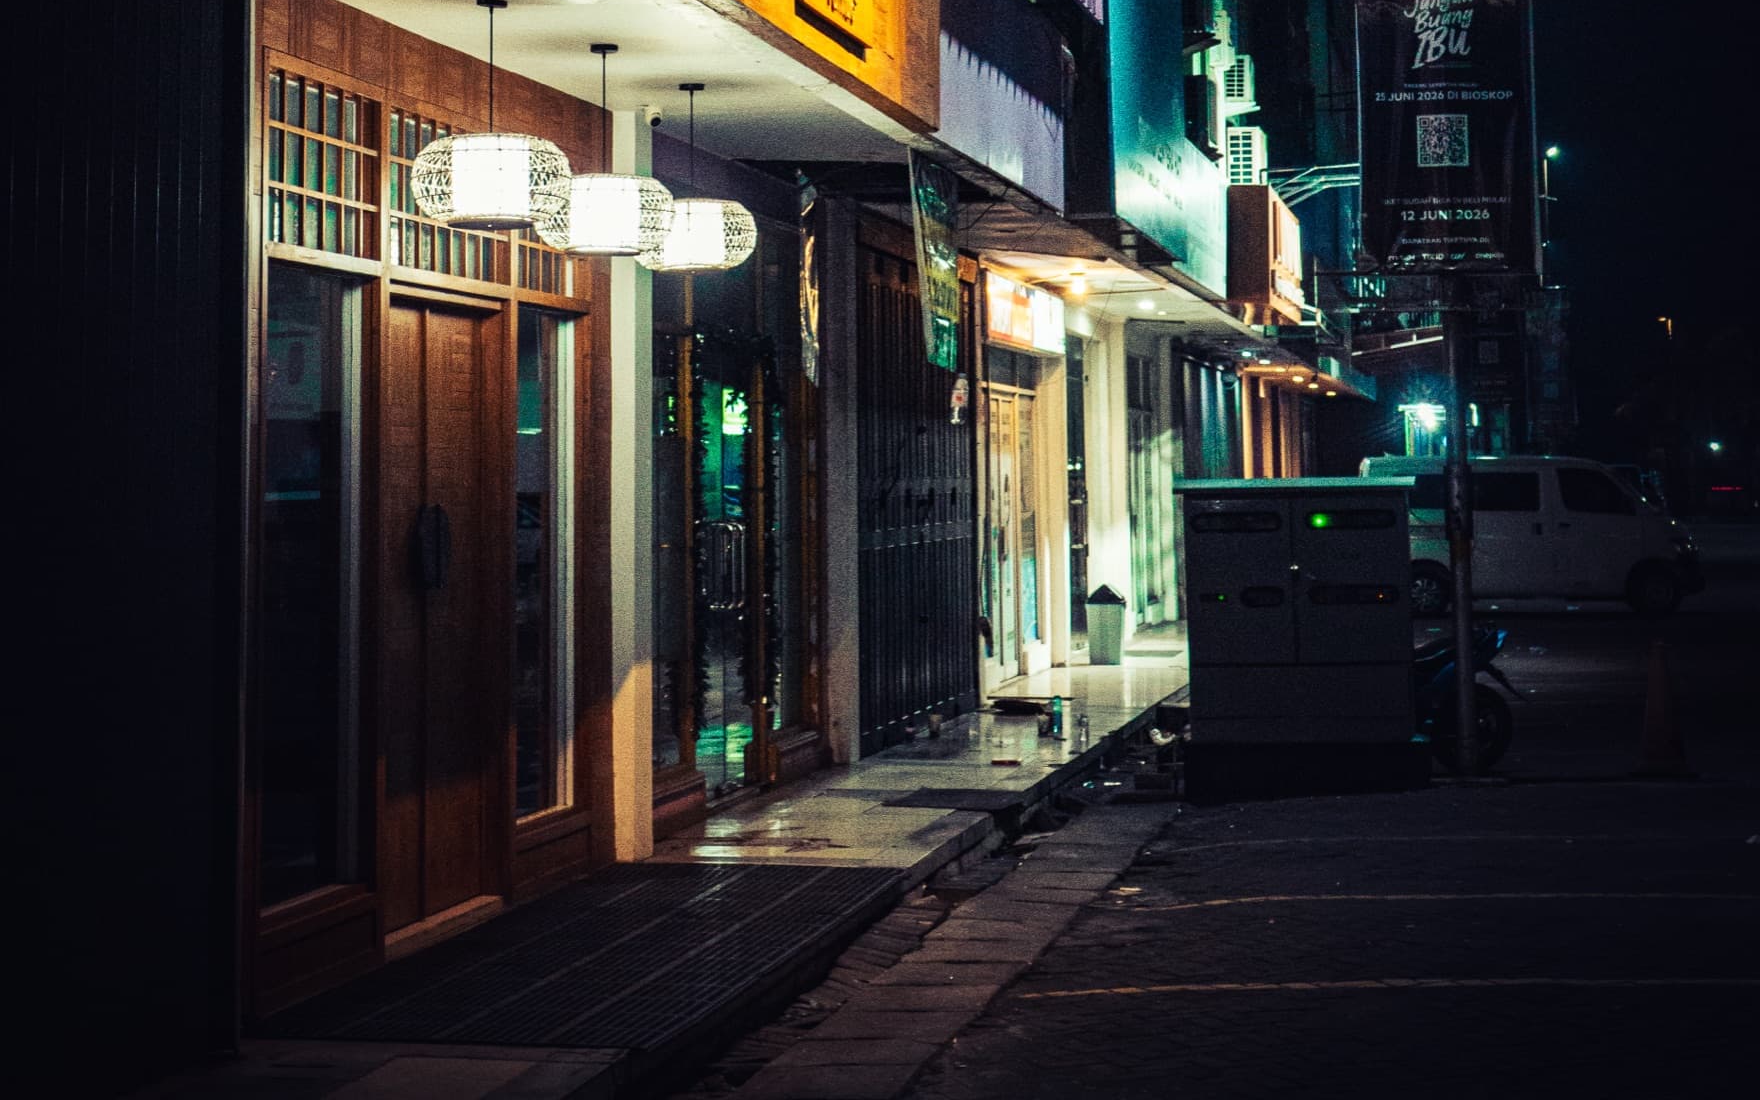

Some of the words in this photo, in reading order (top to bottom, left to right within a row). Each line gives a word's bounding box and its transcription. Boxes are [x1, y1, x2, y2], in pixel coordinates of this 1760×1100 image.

[1414, 8, 1474, 33] Buang
[1375, 92, 1386, 101] 25
[1388, 91, 1415, 101] JUNI
[1417, 91, 1444, 100] 2026
[1447, 90, 1459, 100] DI
[1461, 90, 1513, 100] BIOSKOP
[1400, 210, 1415, 221] 12
[1420, 209, 1453, 220] JUNI
[1455, 208, 1490, 220] 2026
